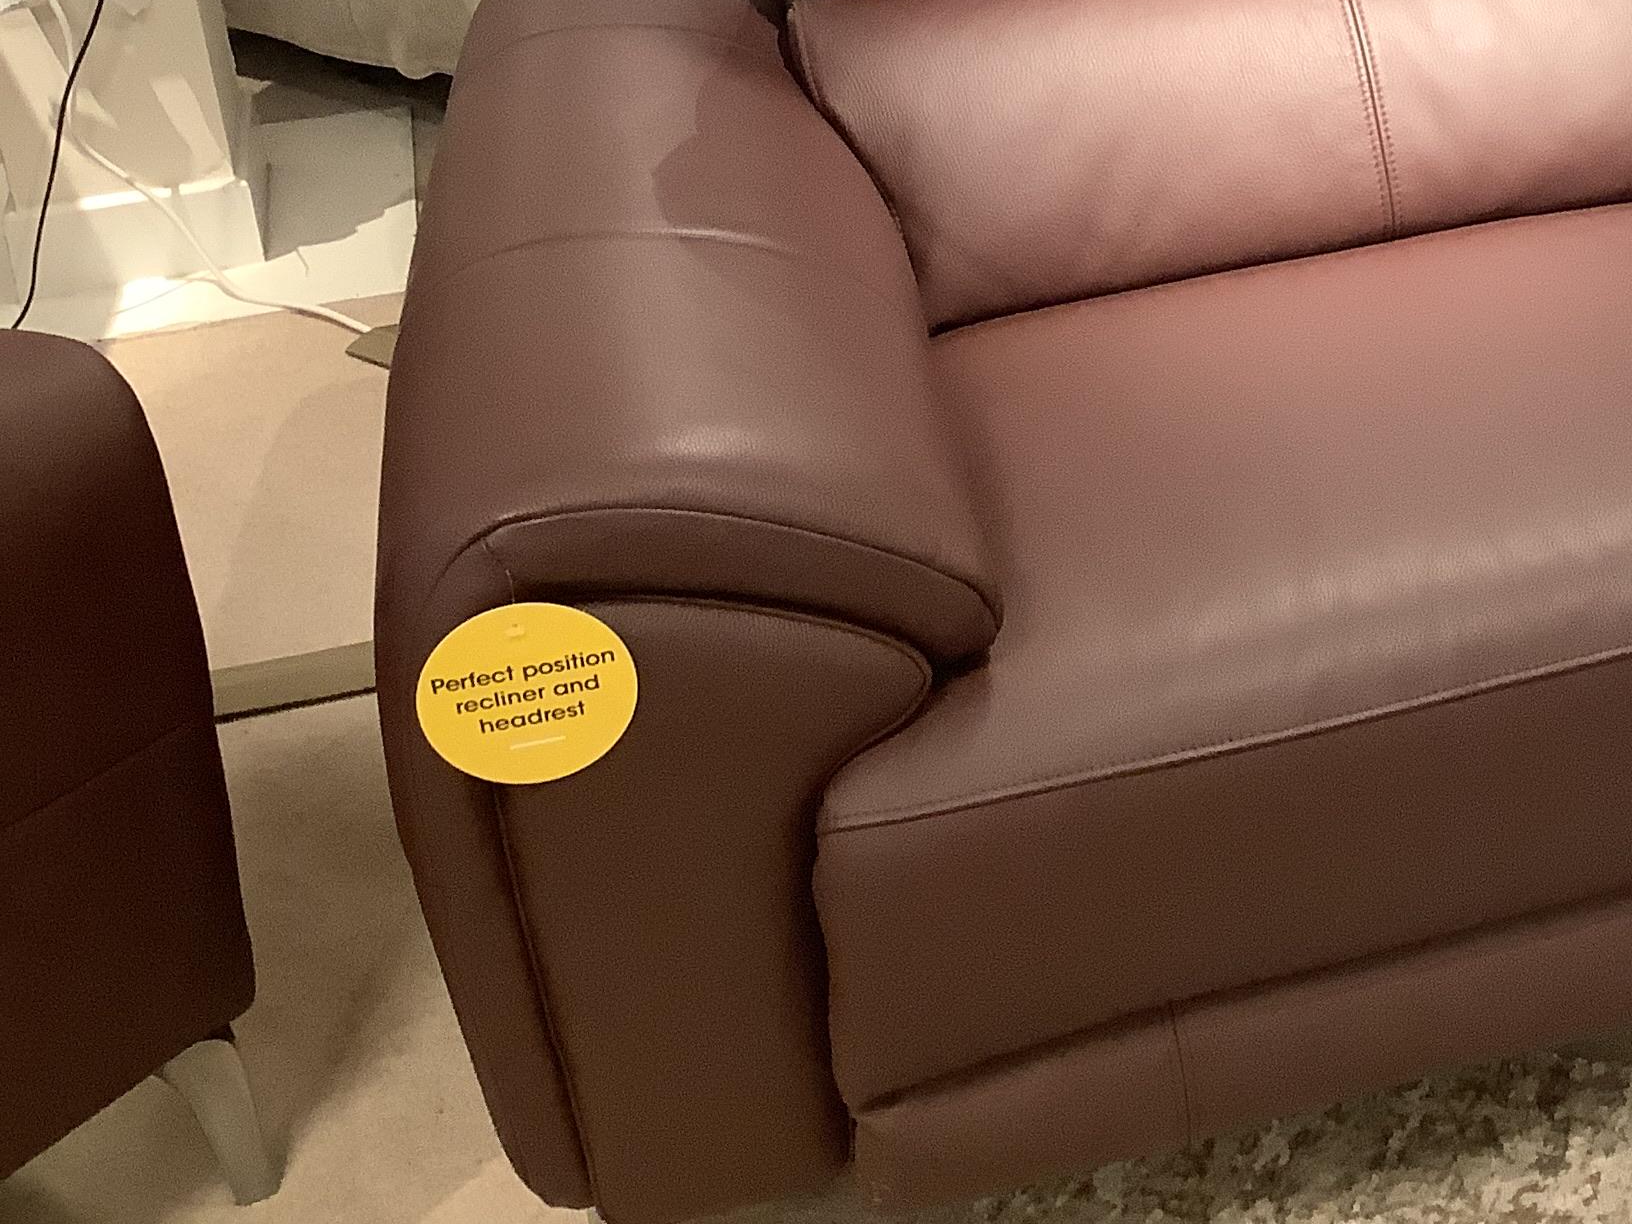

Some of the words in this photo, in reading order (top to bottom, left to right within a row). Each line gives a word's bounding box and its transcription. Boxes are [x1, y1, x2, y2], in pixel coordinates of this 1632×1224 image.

[430, 665, 515, 695] Perfect
[522, 649, 616, 681] position
[455, 685, 546, 715] recliner
[553, 674, 600, 696] and
[479, 700, 586, 734] headrest
